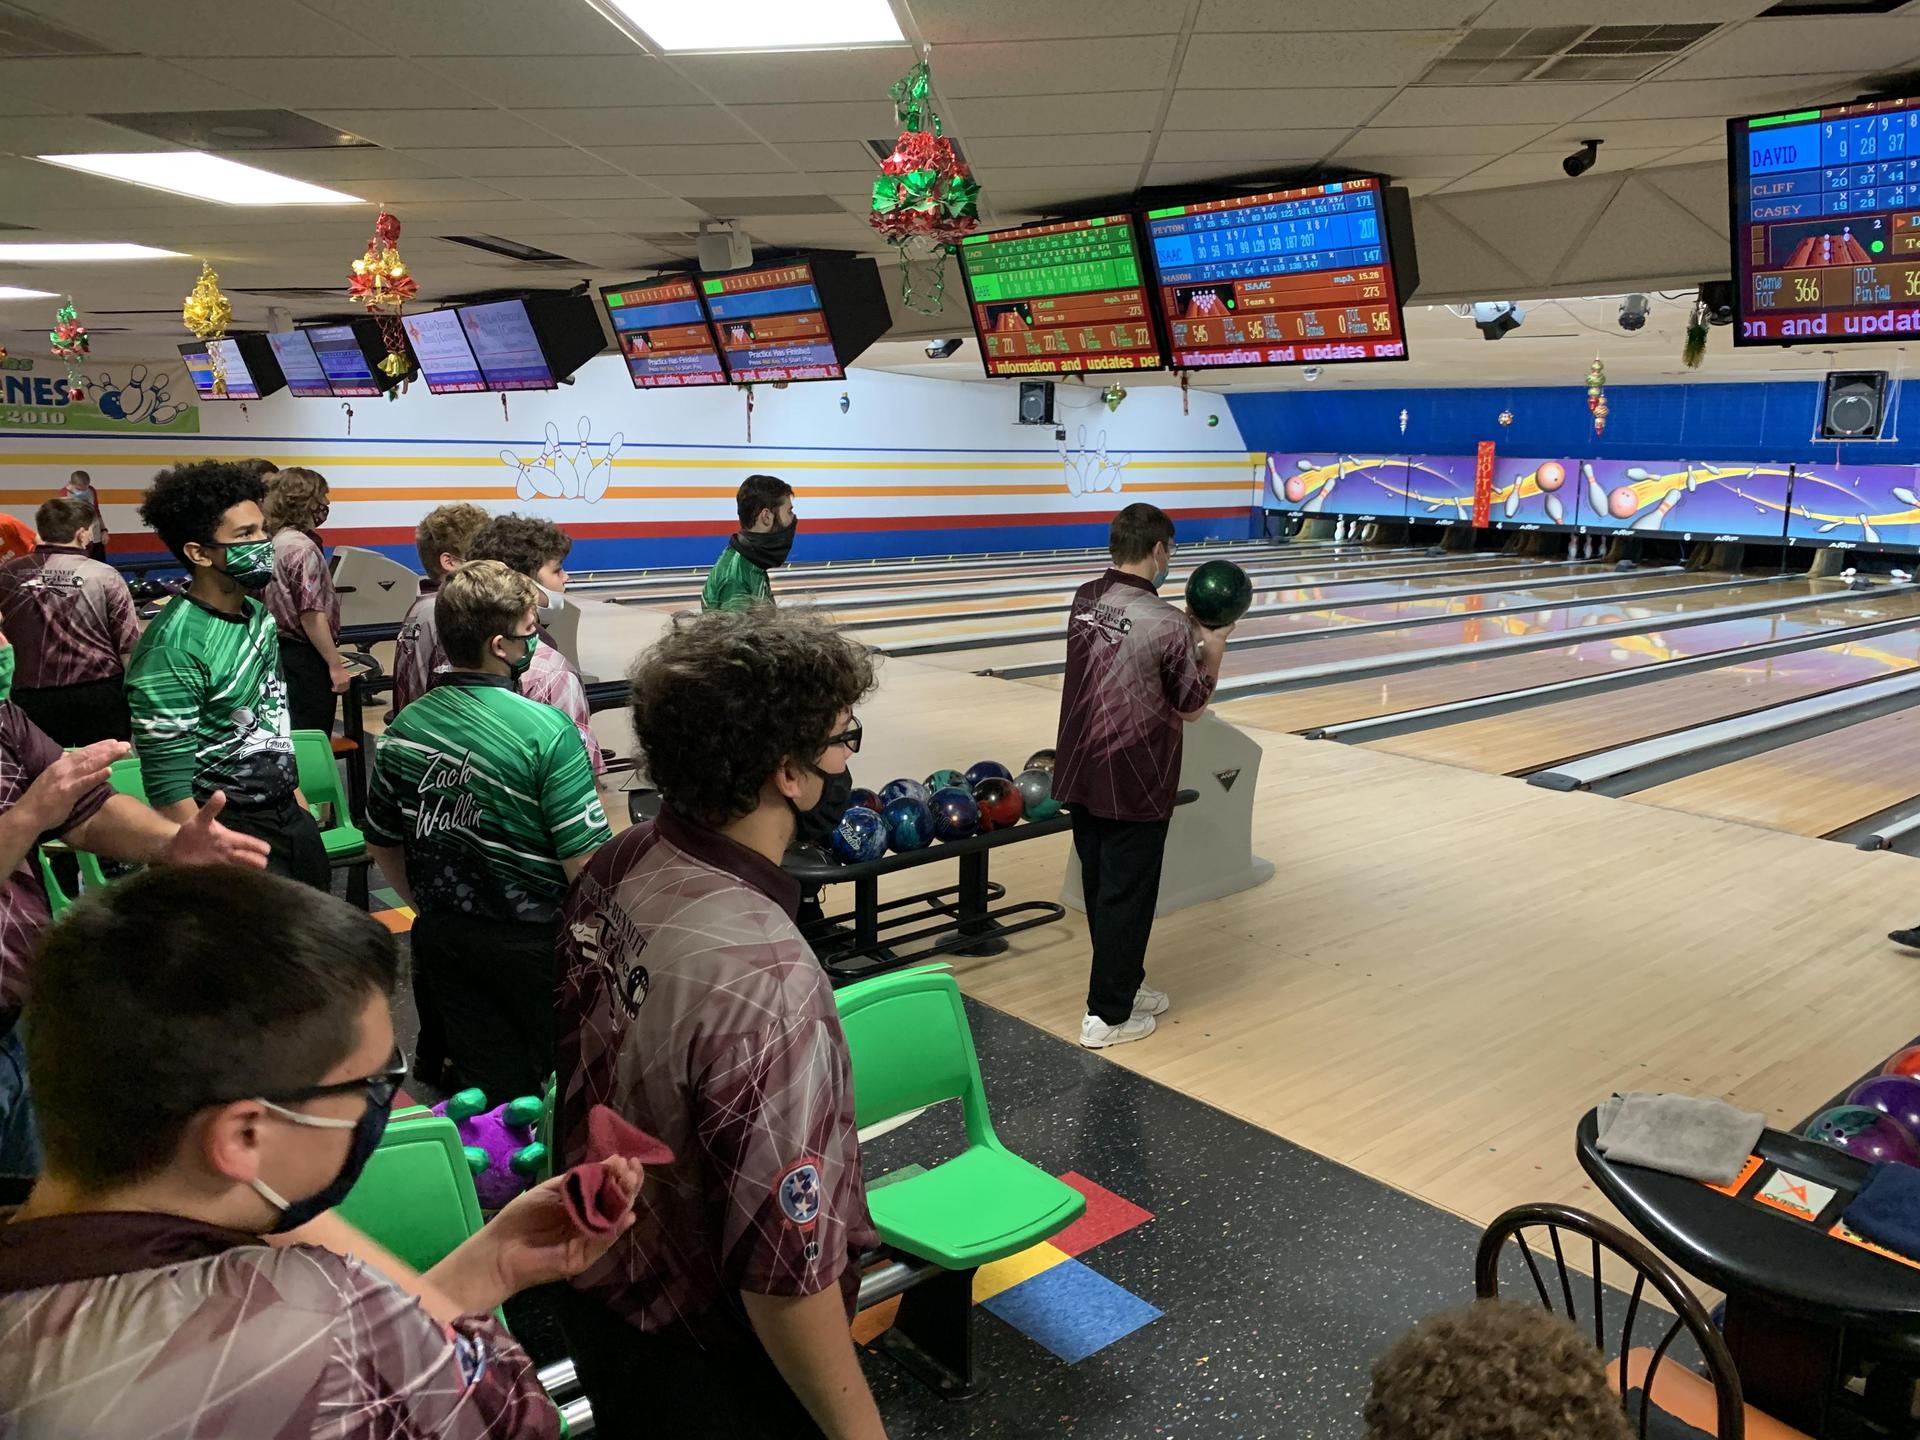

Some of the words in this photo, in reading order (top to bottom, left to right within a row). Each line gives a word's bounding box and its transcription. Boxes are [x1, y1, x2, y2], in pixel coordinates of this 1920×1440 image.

[1752, 145, 1797, 168] DAVID
[1839, 140, 1848, 157] 9
[1860, 137, 1876, 155] 28
[1888, 133, 1905, 151] 37
[1753, 182, 1795, 196] CLIFF
[1831, 177, 1848, 188] 20
[1860, 173, 1876, 185] 37
[1888, 171, 1904, 181] 44
[1153, 223, 1185, 235] PEYTON
[1263, 212, 1277, 221] 103
[1280, 209, 1294, 218] 122
[1297, 207, 1311, 216] 131
[1314, 205, 1328, 214] 151
[1332, 202, 1346, 211] 171
[1356, 195, 1372, 207] 171
[1754, 204, 1802, 218] CASEY
[1832, 200, 1848, 211] 19
[1860, 198, 1876, 208] 28
[1888, 194, 1904, 205] 48
[1300, 233, 1315, 247] 207
[1358, 218, 1375, 239] 207
[1873, 219, 1882, 229] 2
[1162, 272, 1192, 283] MASON
[1305, 260, 1319, 269] 147
[1363, 249, 1380, 262] 147
[1244, 280, 1271, 291] ISAAC
[1358, 271, 1380, 281] 15.26
[1755, 275, 1783, 291] Game
[1794, 277, 1820, 302] 366
[1362, 286, 1380, 298] 273
[1243, 298, 1266, 307] Team
[1247, 320, 1265, 339] 545
[1371, 311, 1391, 331] 545
[1781, 313, 1828, 336] and
[1192, 325, 1209, 343] 545
[747, 350, 772, 359] Practice
[773, 349, 786, 357] Has
[1181, 348, 1262, 366] information
[1267, 345, 1296, 362] and
[1302, 343, 1367, 360] updates
[995, 358, 1057, 374] information
[1060, 356, 1082, 371] and
[1086, 355, 1135, 370] updates
[0, 375, 70, 406] NES
[1495, 522, 1503, 530] 4
[1579, 525, 1586, 534] 5
[1683, 533, 1691, 541] 6
[1788, 537, 1797, 546] 7
[418, 750, 472, 794] Zach
[416, 793, 484, 840] Wallin
